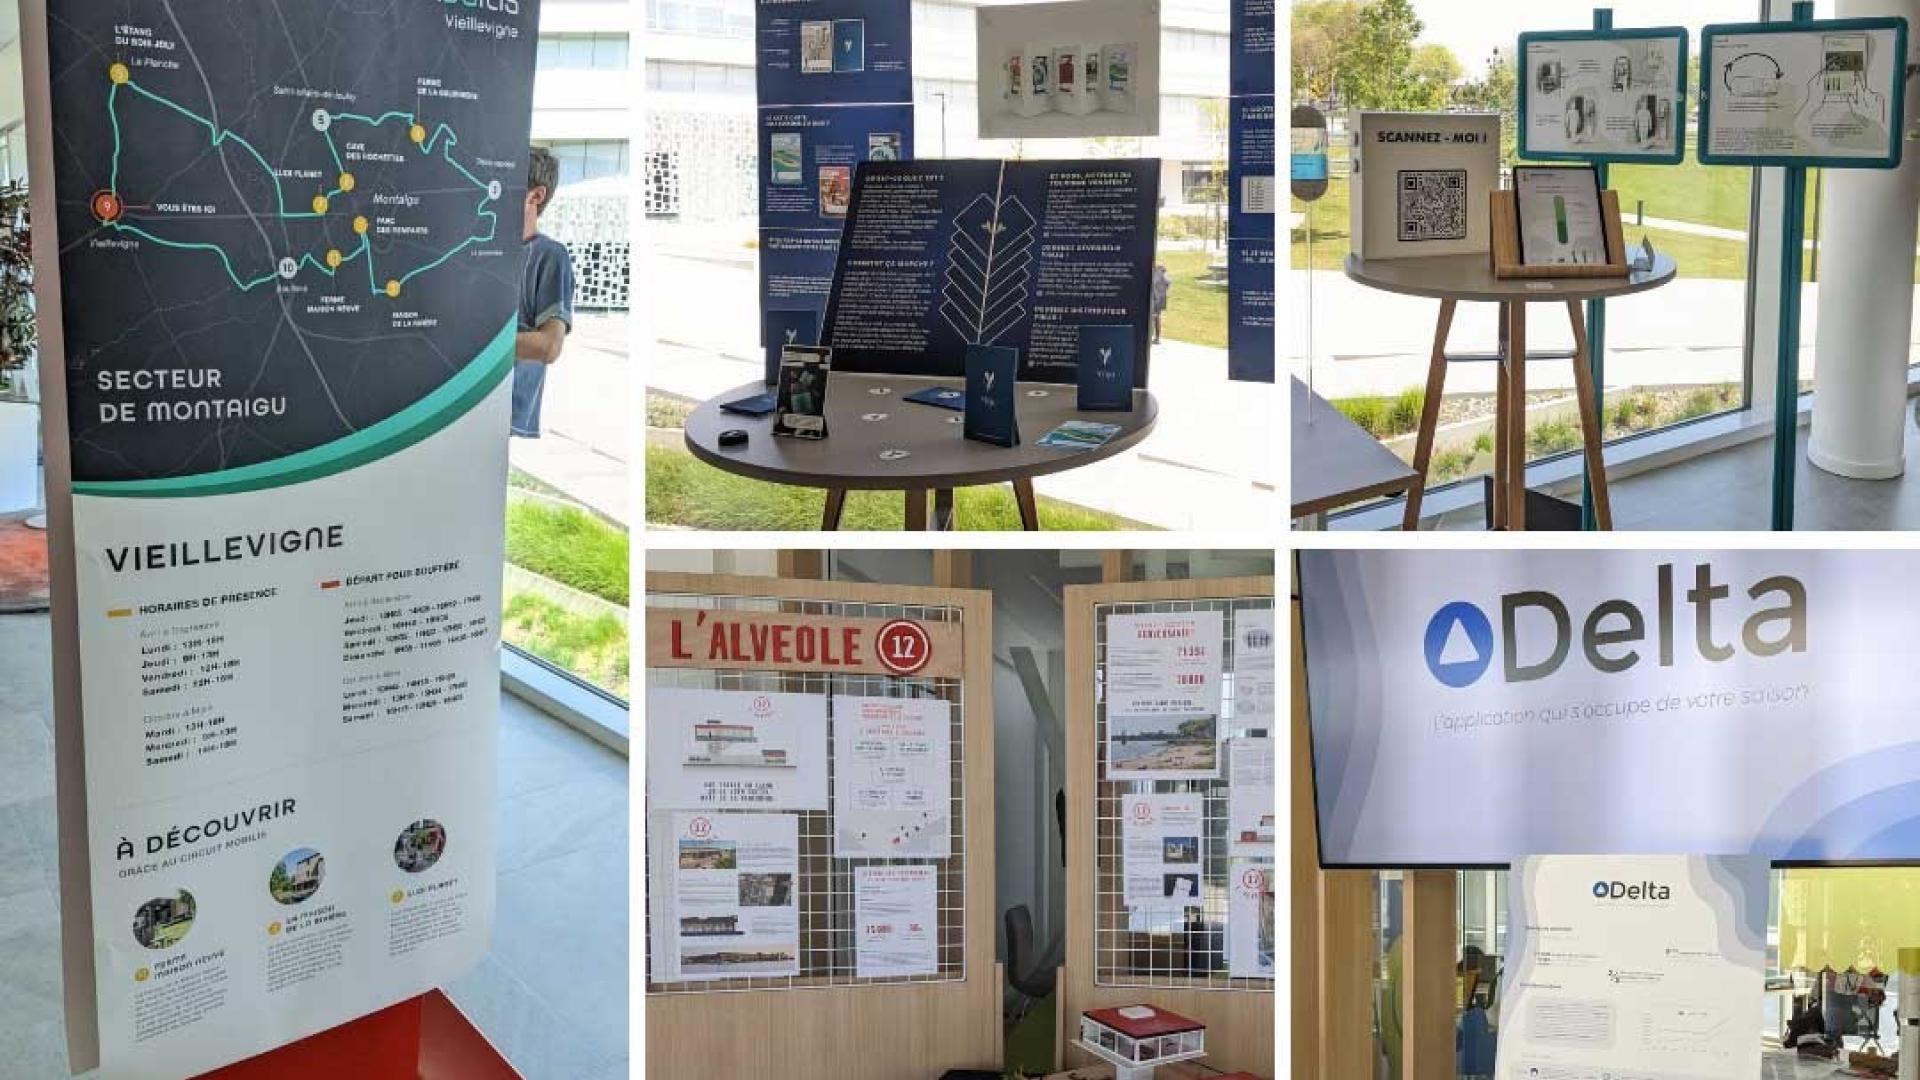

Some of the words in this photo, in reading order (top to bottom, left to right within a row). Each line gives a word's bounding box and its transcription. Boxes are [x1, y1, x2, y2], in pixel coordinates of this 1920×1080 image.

[445, 14, 518, 39] Vieillevigne
[1378, 130, 1441, 143] SCANNEZ
[1452, 132, 1479, 143] MOI
[156, 203, 177, 213] VOUS
[97, 368, 222, 391] SECTEUR
[99, 403, 136, 422] DE
[147, 397, 287, 421] MONTAIGU
[106, 525, 344, 572] VIEILLEVIGNE
[139, 600, 200, 615] HORAIRES
[202, 598, 218, 607] DE
[1501, 562, 1807, 683] Delta
[671, 611, 862, 665] L'ALVEOLE
[892, 635, 915, 658] 12
[142, 645, 171, 655] Lundi
[142, 659, 170, 669] Jeudi
[142, 669, 188, 682] Vendredi
[142, 684, 181, 696] Samedi
[1434, 713, 1535, 733] L'application
[1540, 709, 1567, 725] qui
[1570, 700, 1651, 721] s'occupe
[1656, 695, 1681, 712] de
[1686, 693, 1734, 710] votre
[145, 728, 175, 739] Mardi
[145, 738, 192, 752] Mercredi
[146, 752, 184, 766] Samedi
[116, 837, 134, 861] À
[147, 799, 296, 854] DÉCOUVRIR
[162, 857, 178, 870] AU
[180, 845, 223, 862] CIRCUIT
[1610, 881, 1671, 901] Delta
[154, 961, 193, 980] MAISON
